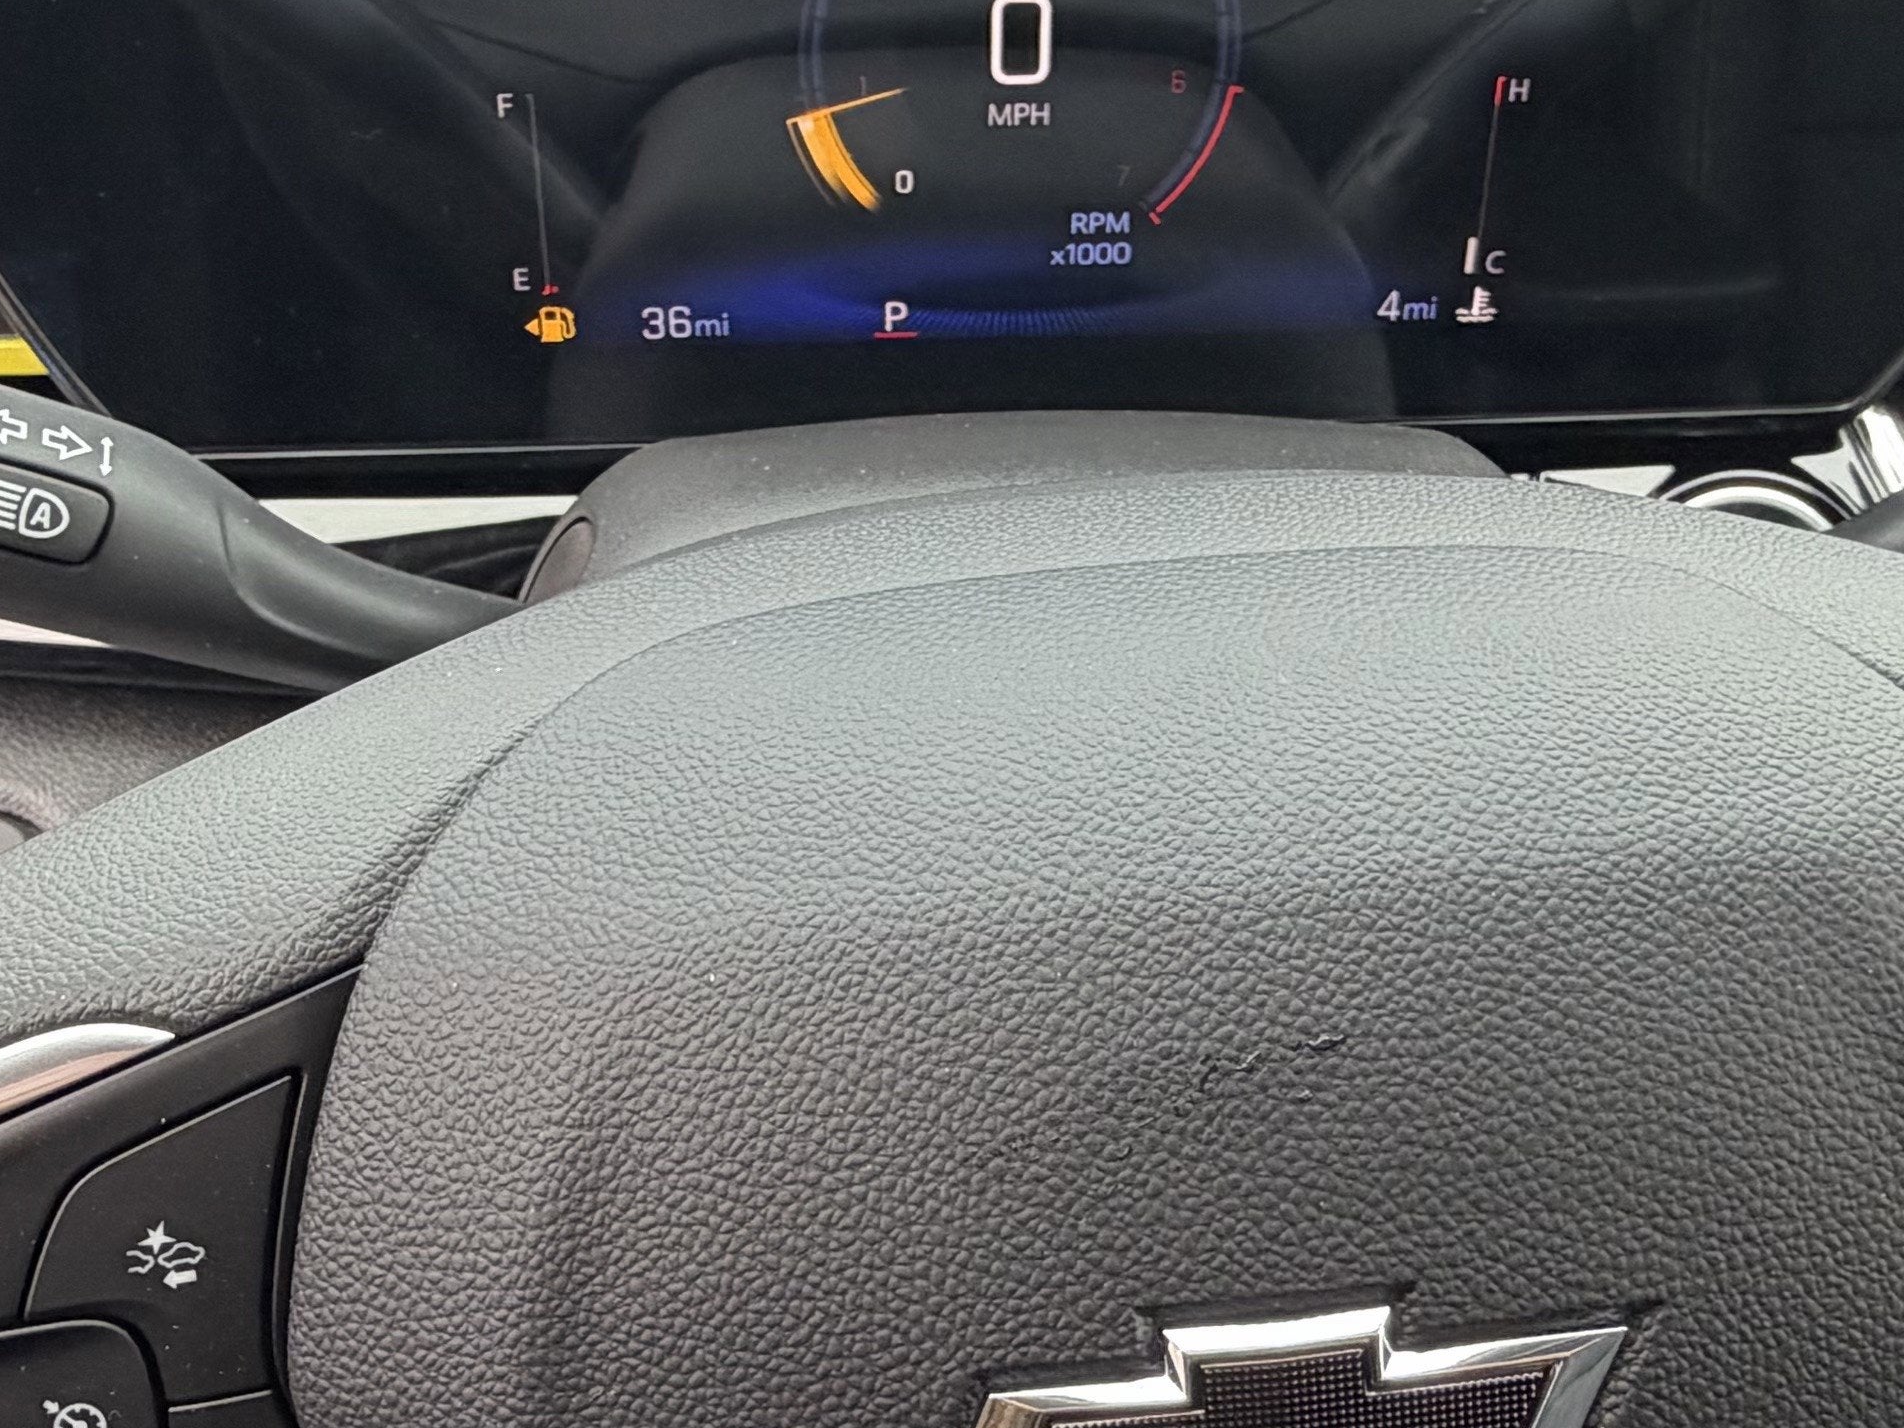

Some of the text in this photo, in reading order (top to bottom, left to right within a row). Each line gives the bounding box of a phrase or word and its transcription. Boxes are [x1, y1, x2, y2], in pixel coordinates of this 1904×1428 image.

[1170, 71, 1187, 94] 6
[1508, 78, 1531, 103] H
[497, 93, 513, 118] F
[987, 103, 1051, 128] MPH
[895, 169, 914, 194] 0
[1070, 211, 1131, 235] RPM
[1049, 242, 1132, 267] x1000
[1485, 250, 1507, 275] C
[513, 267, 530, 291] E
[884, 302, 908, 331] P
